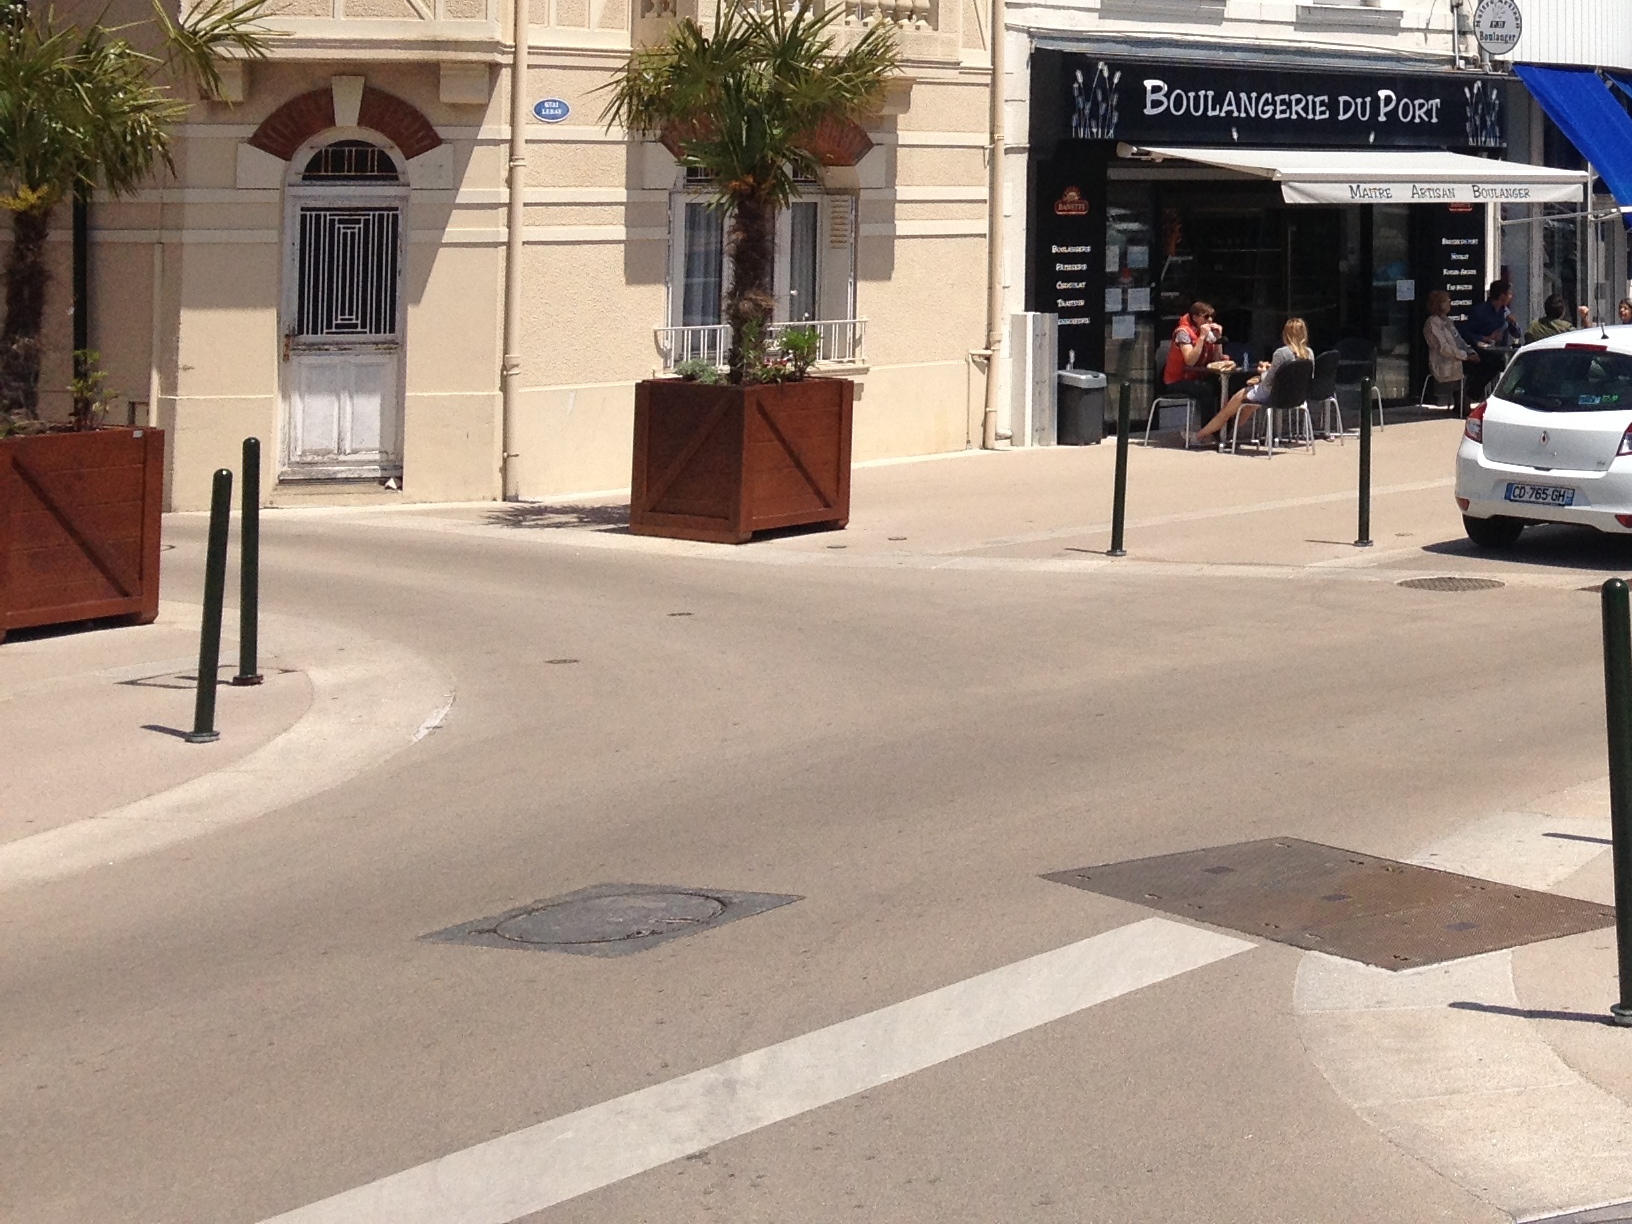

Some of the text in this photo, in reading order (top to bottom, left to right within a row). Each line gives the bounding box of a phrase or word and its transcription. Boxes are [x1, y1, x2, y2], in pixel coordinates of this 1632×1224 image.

[1479, 31, 1516, 44] Boulanger
[1143, 79, 1441, 123] BOULANGERIE DU PORT
[1411, 184, 1456, 200] ARTISAN
[1471, 184, 1531, 200] BOULANGER
